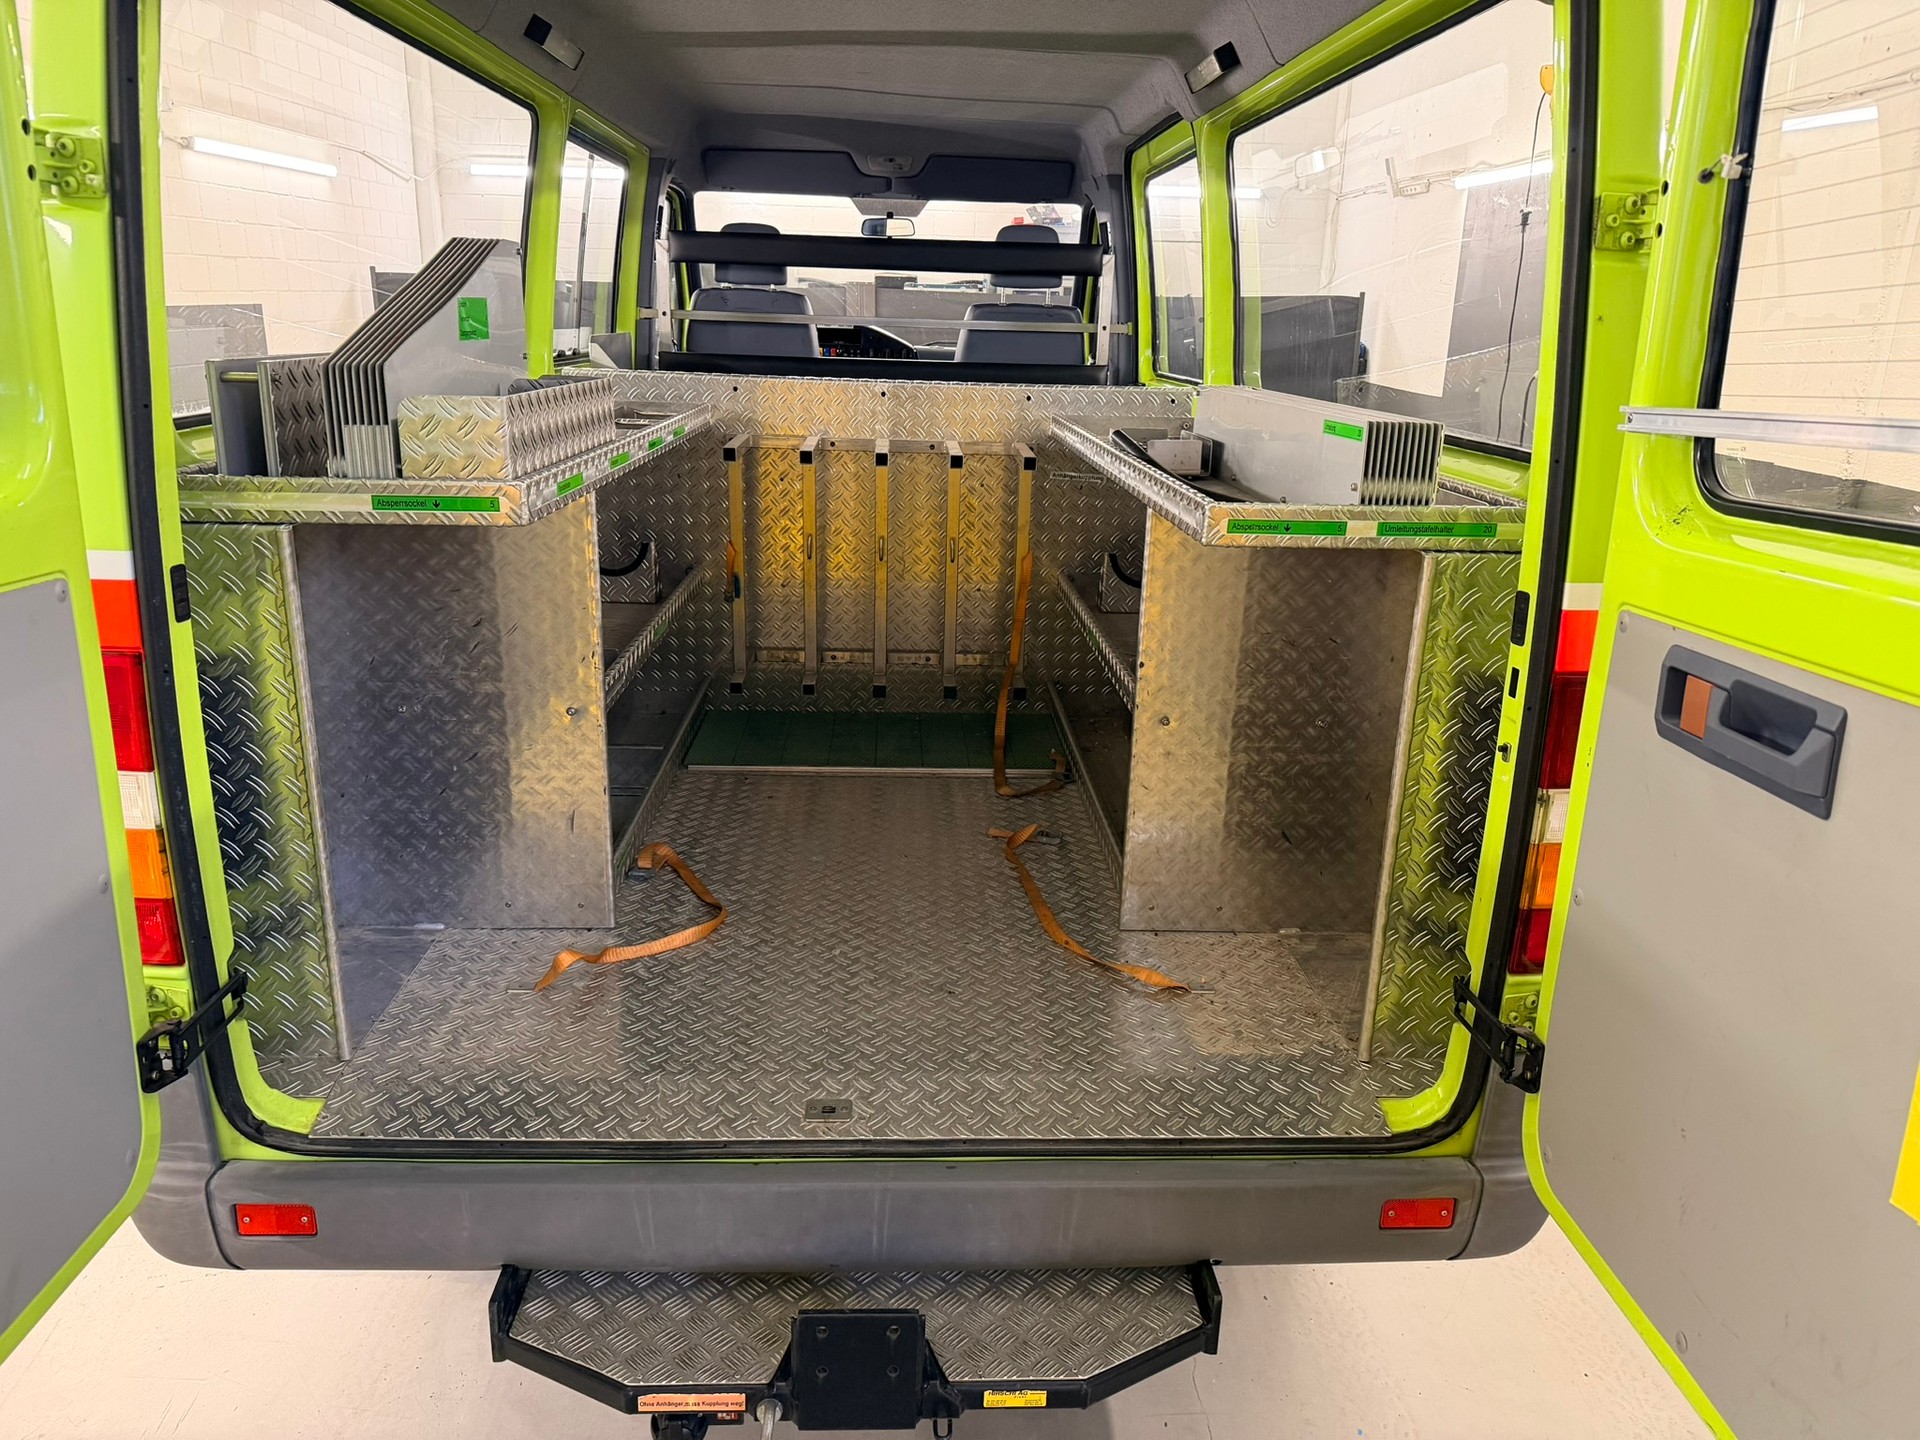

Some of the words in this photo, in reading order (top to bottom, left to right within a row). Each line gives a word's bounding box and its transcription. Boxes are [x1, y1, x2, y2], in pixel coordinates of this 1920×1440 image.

[376, 499, 428, 508] Absperrsockel
[1231, 523, 1279, 532] Absperrsockel
[1337, 525, 1342, 533] 5
[1384, 525, 1454, 535] Umleitungstafelhalter
[1483, 525, 1493, 534] 20
[701, 1400, 730, 1408] Kupplung
